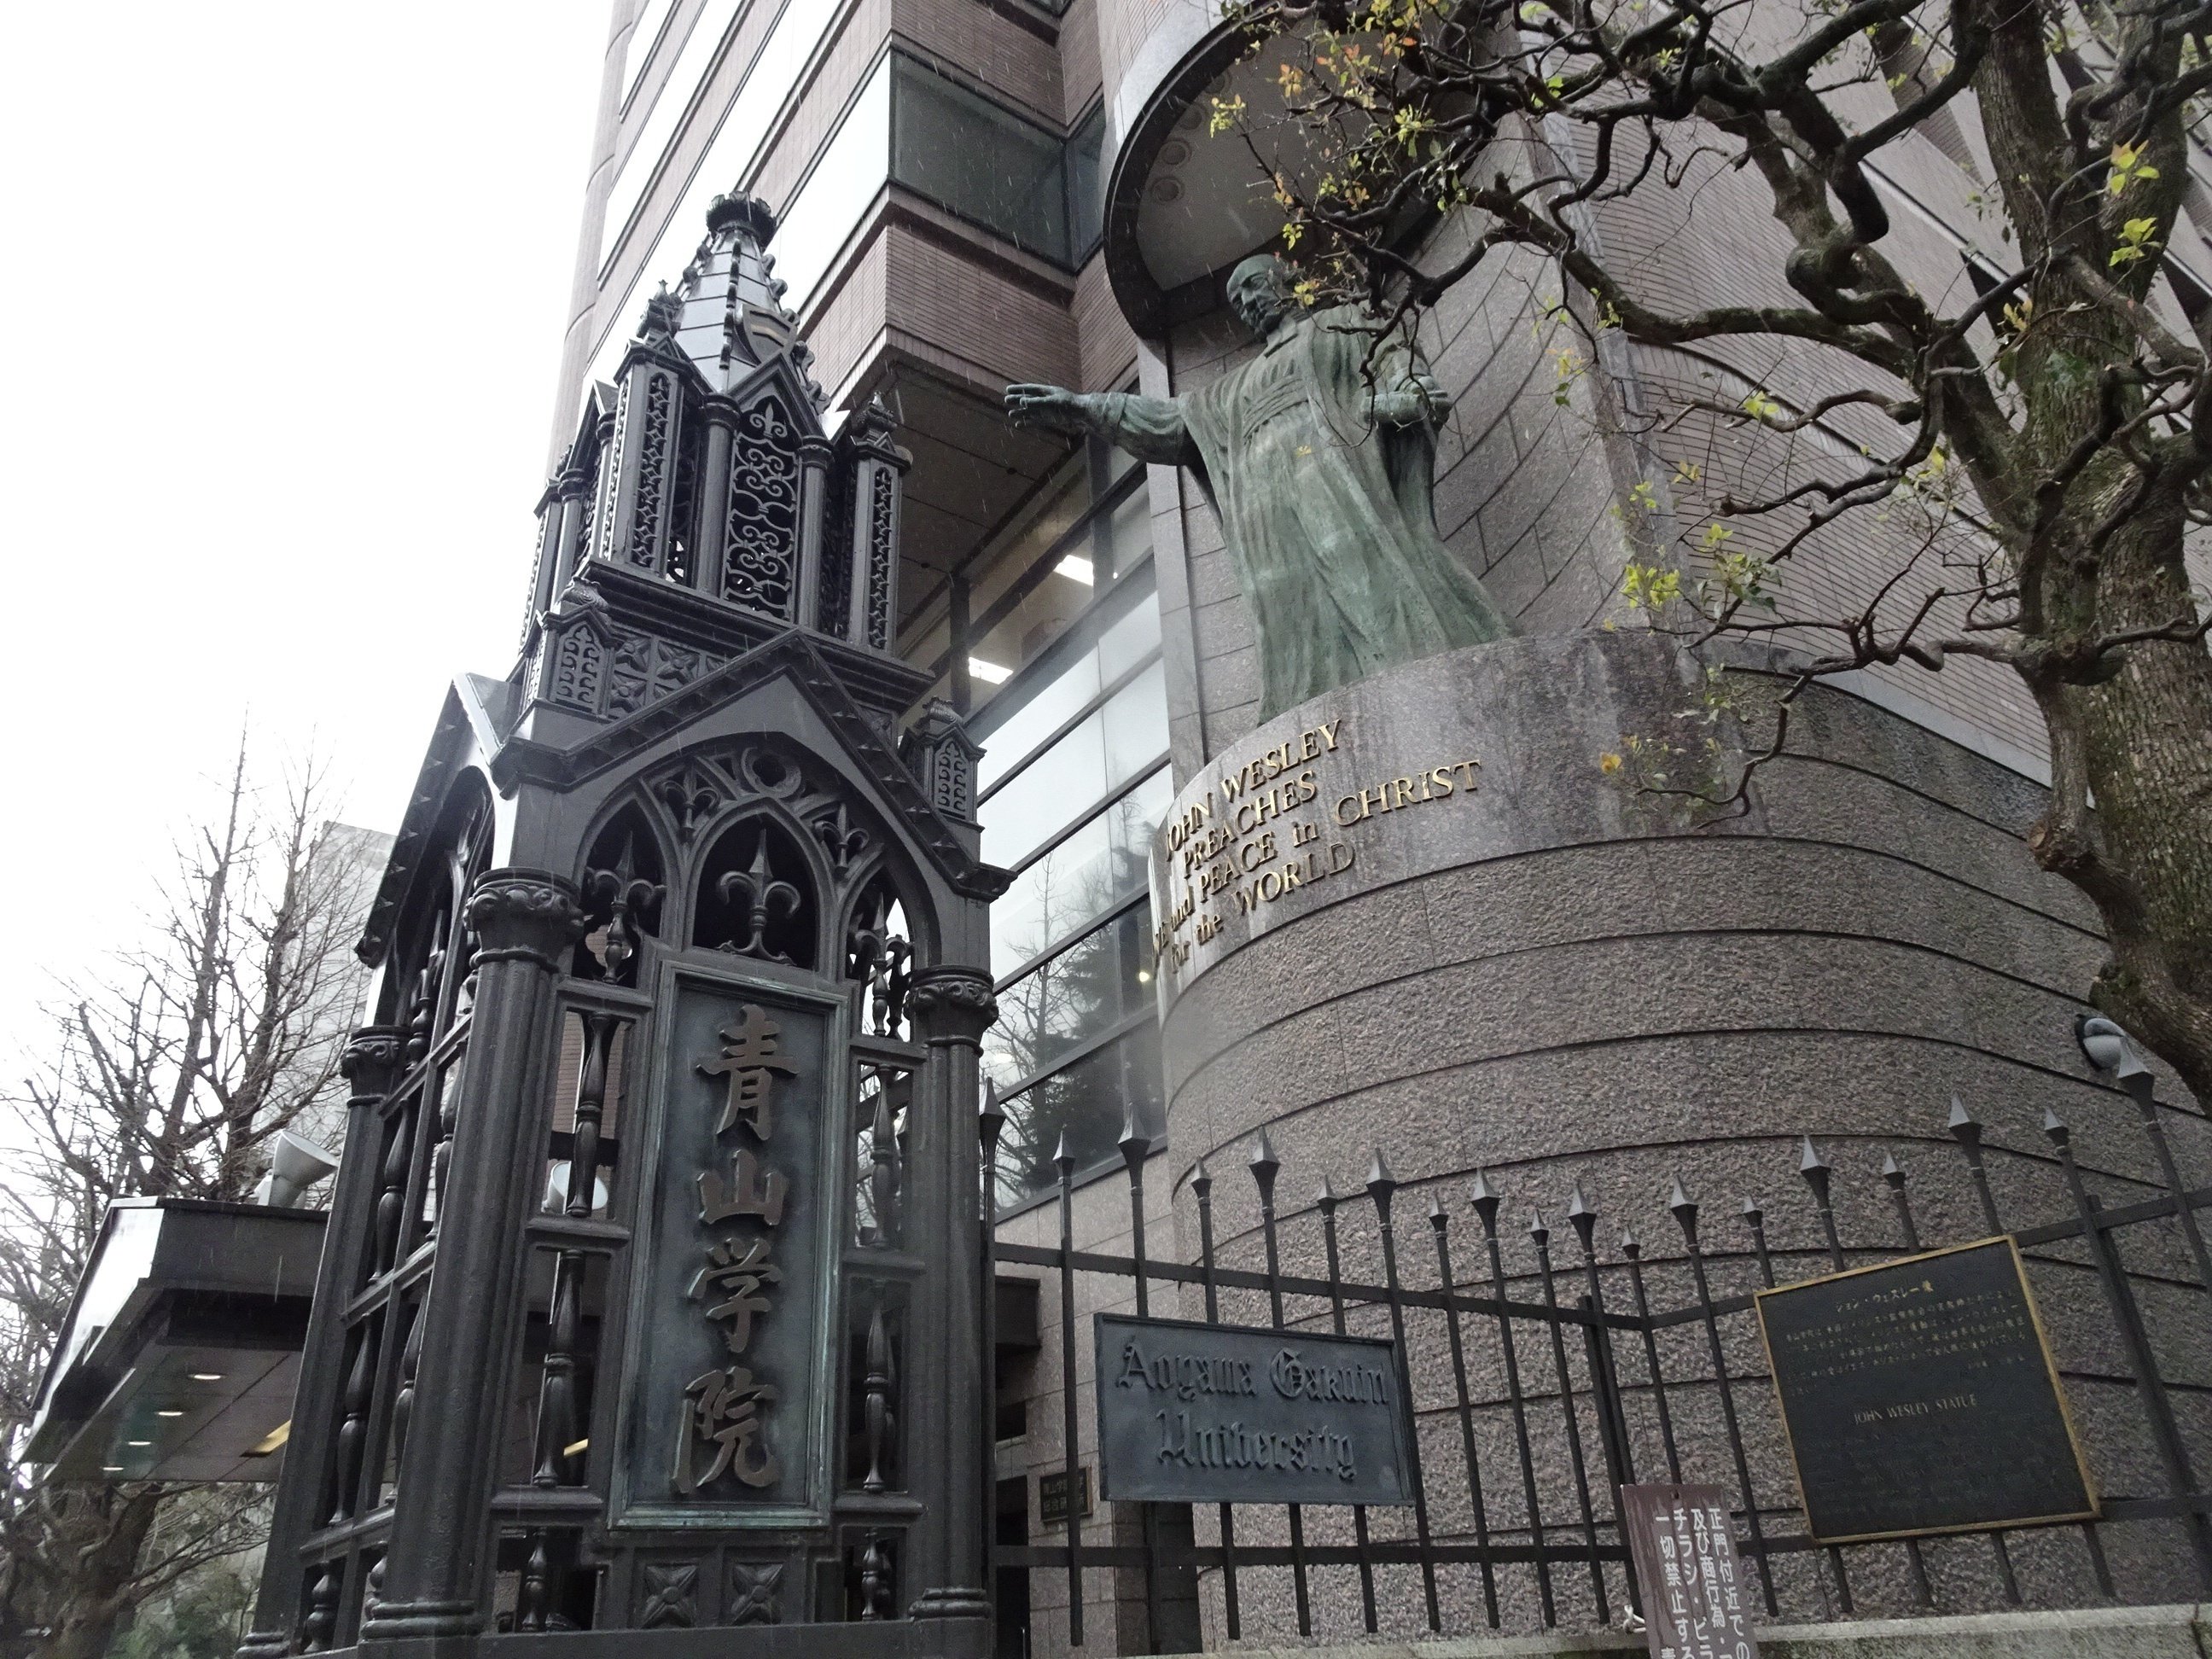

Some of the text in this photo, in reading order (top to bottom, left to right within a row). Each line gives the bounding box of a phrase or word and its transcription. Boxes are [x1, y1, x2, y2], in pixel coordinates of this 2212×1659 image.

[1167, 719, 1341, 862] JOHN WESLEY
[1184, 770, 1317, 879] PREACHES
[1200, 830, 1278, 903] PEACE
[1292, 821, 1319, 847] in
[1333, 760, 1481, 828] CHRIST
[1172, 841, 1357, 974] for the WORLD
[671, 1002, 800, 1495] 青山学院
[1115, 1335, 1390, 1405] Aoyama Gakuin
[1854, 1393, 1978, 1426] JOHN WESLEY STATUE
[1155, 1408, 1358, 1481] University
[1691, 1508, 1732, 1659] 及び商行為・
